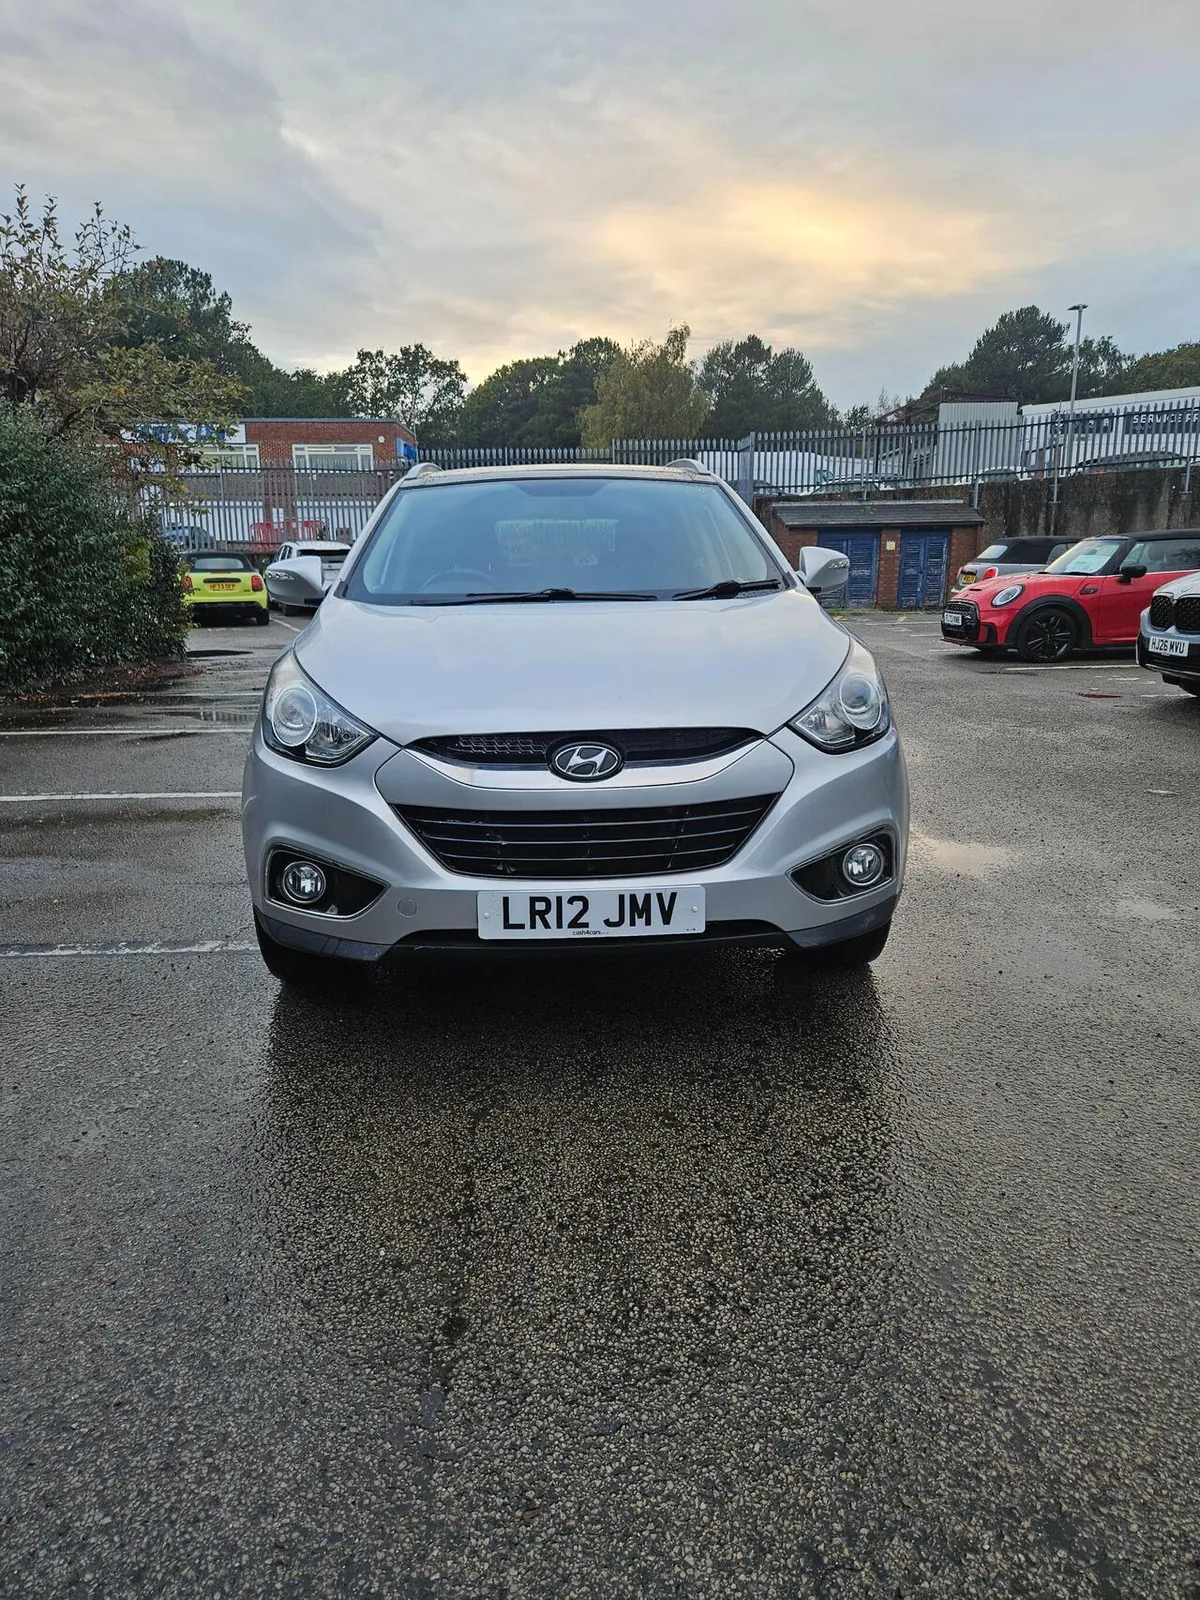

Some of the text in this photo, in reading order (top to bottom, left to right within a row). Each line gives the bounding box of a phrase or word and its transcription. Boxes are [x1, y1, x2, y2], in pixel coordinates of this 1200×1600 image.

[1151, 638, 1168, 651] HJ26
[502, 892, 677, 930] LR12 JMV
